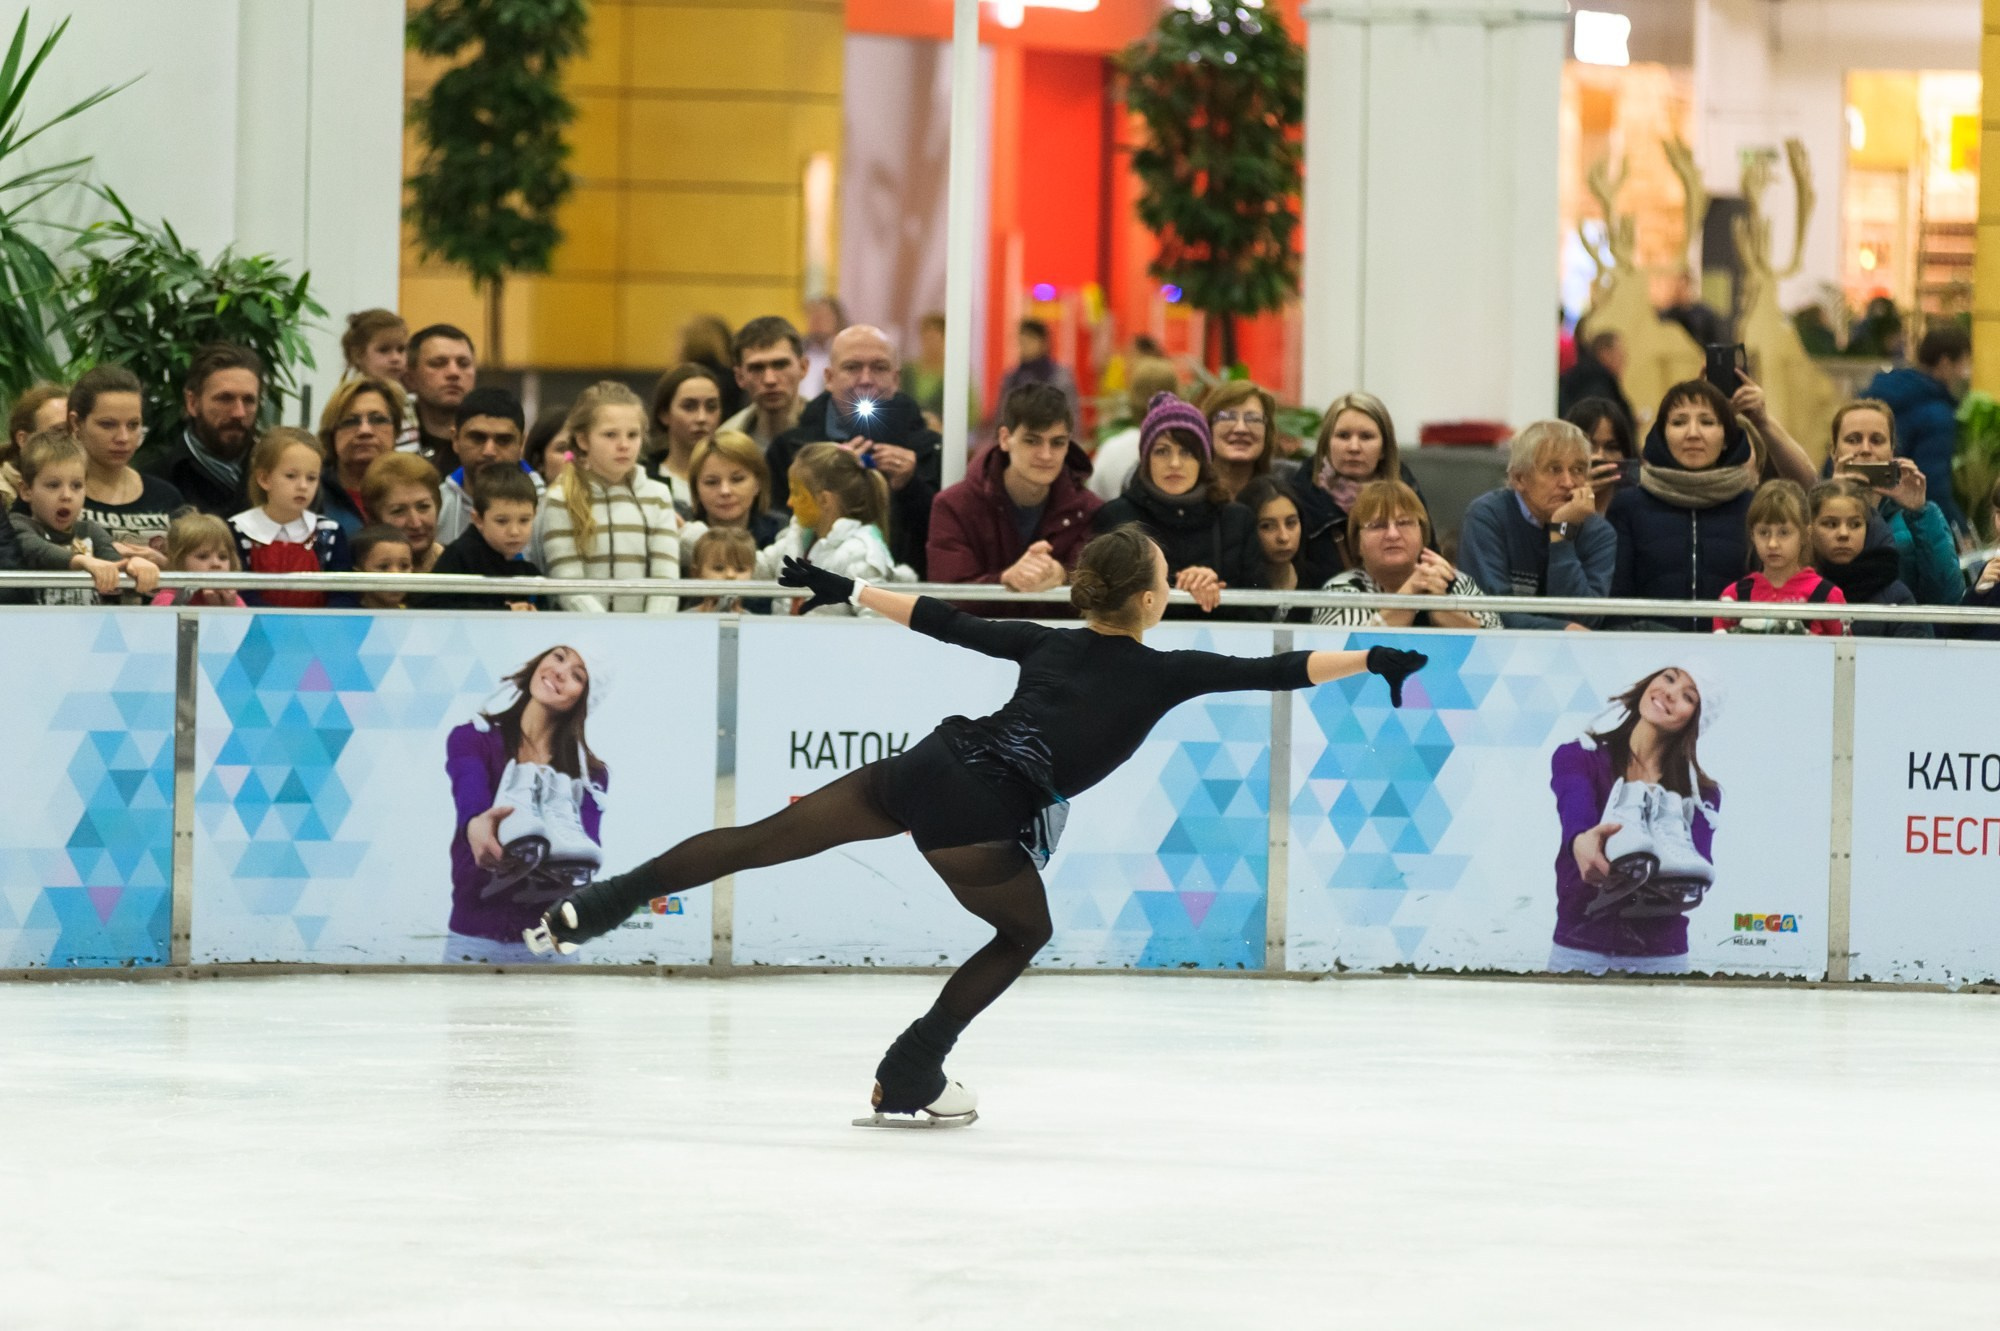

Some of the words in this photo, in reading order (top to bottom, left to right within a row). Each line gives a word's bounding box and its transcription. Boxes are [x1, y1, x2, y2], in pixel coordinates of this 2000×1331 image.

[78, 508, 120, 528] ELLO
[789, 731, 909, 769] КАТОК
[1908, 751, 2000, 793] КАТО
[1906, 815, 2000, 856] БЕСП
